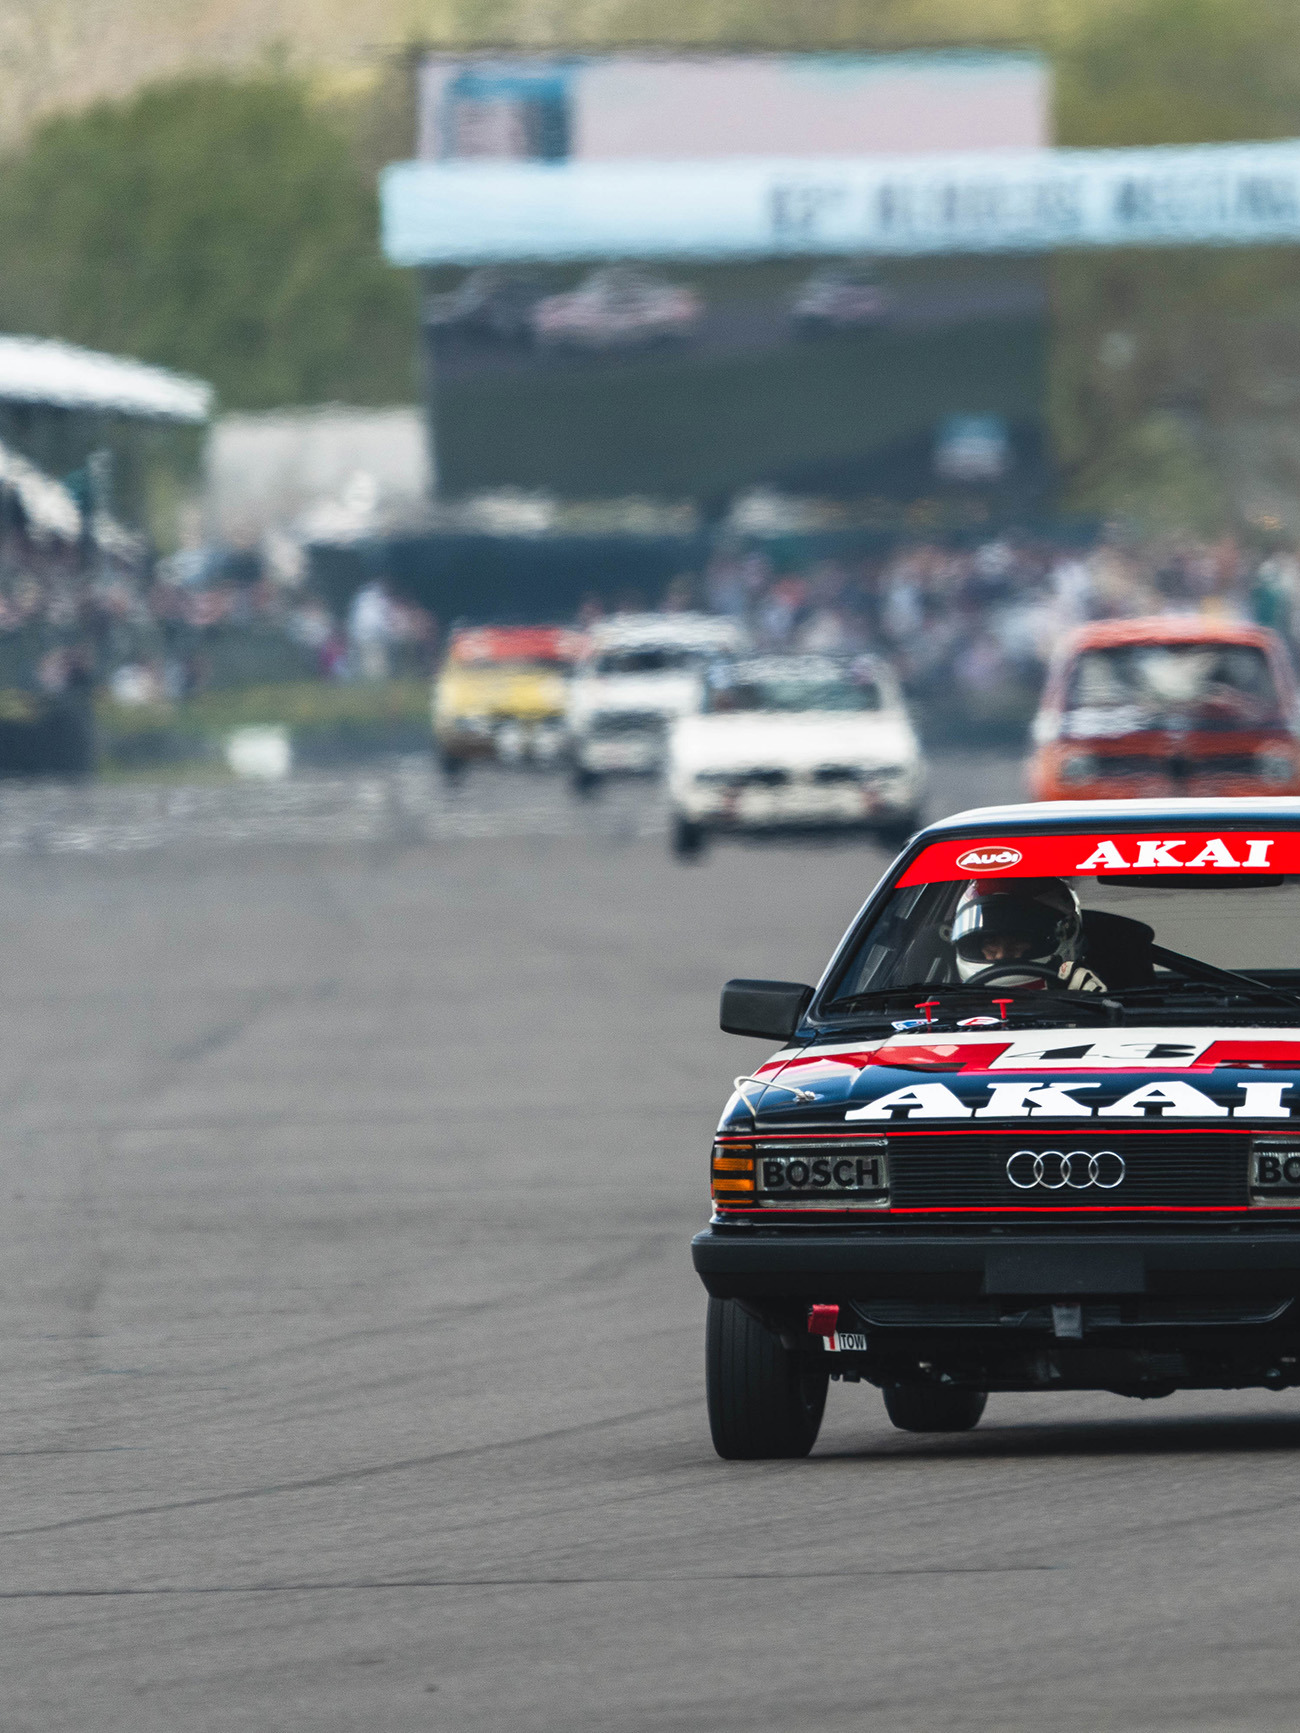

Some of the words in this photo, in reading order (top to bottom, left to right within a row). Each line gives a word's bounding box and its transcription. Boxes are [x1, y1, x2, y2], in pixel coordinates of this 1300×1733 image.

[1076, 840, 1274, 869] AKAI
[844, 1081, 1293, 1118] AKAI
[762, 1159, 880, 1187] BOSCH
[840, 1333, 864, 1349] TOW
